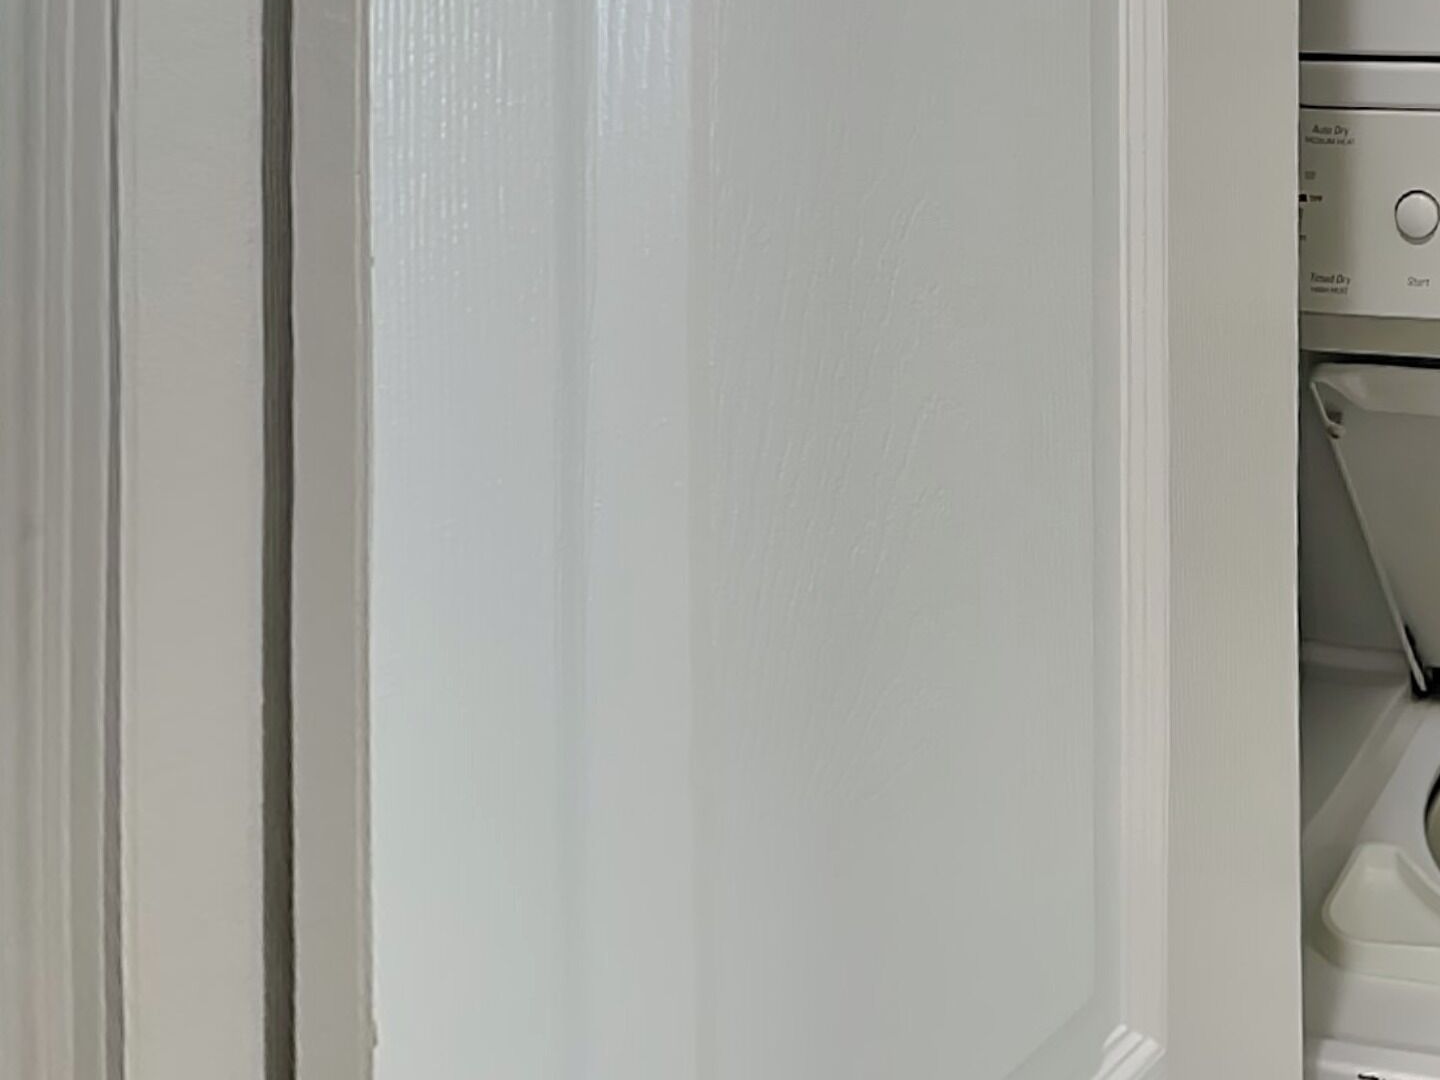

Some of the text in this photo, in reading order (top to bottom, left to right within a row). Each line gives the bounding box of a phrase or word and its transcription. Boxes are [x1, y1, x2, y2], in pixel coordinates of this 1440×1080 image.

[1312, 124, 1349, 137] Auto Dry
[1336, 273, 1351, 286] Dry
[1407, 276, 1430, 287] Start
